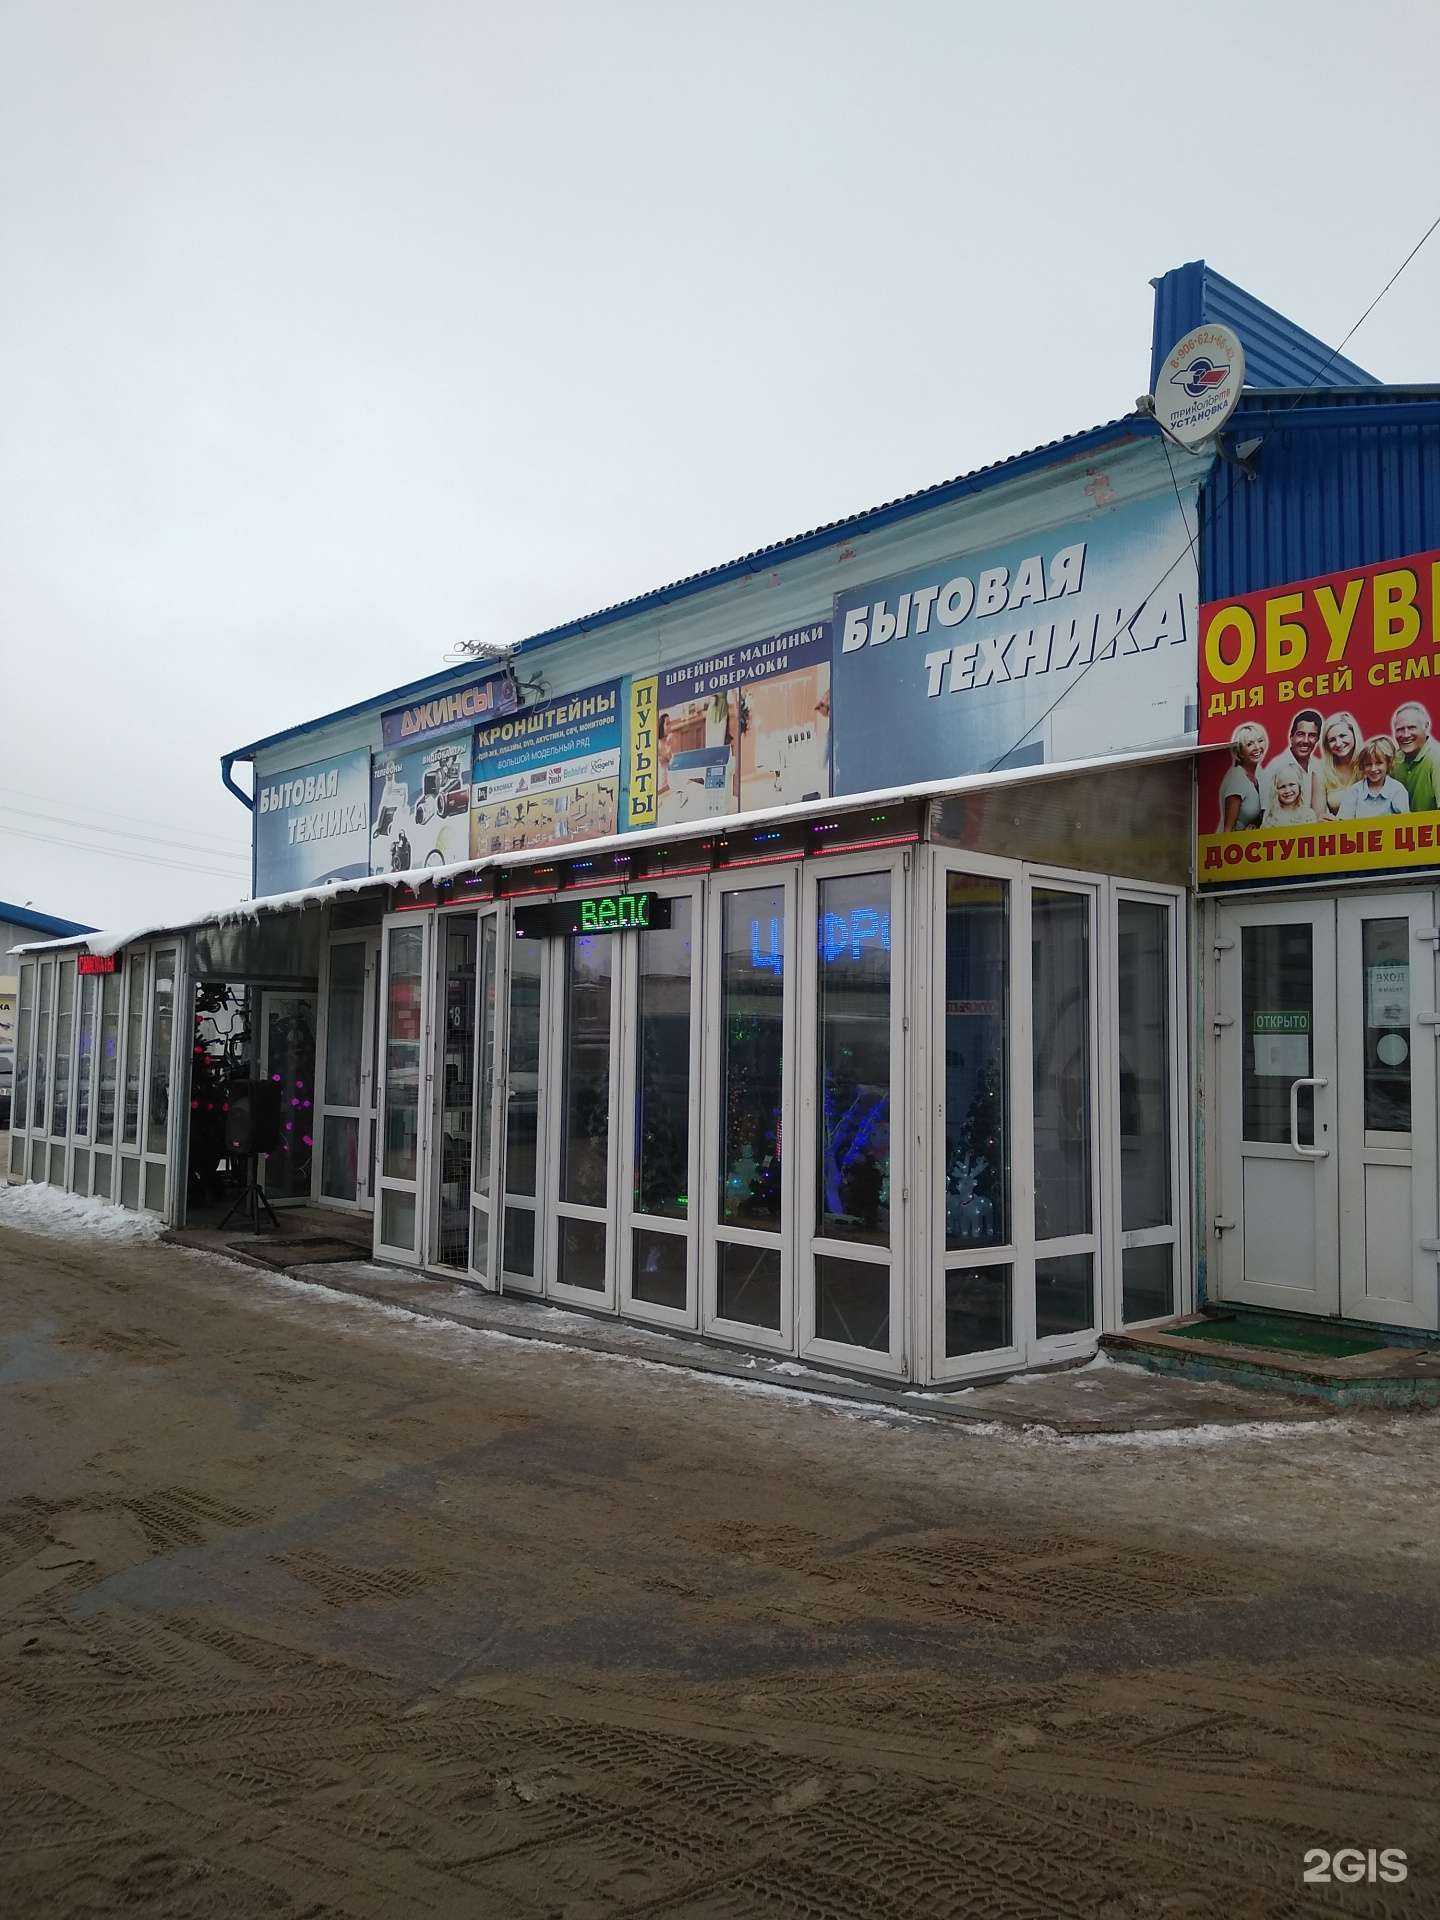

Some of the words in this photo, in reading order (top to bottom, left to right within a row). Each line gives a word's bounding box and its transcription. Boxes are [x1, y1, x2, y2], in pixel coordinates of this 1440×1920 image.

[1170, 400, 1228, 430] УСТАНОВКА
[842, 543, 1088, 654] БЫТОВАЯ
[666, 653, 736, 686] ШВЕЙНЫЕ
[739, 625, 823, 662] МАШИНКИ
[923, 592, 1188, 698] ТЕХНИКА
[694, 680, 704, 694] И
[709, 655, 789, 690] ОВЕРЛОКИ
[1207, 684, 1264, 718] ДЛЯ
[1278, 665, 1353, 703] ВСЕЙ
[401, 682, 494, 737] ДЖИНСЫ
[479, 690, 616, 748] КРОНШТЕЙНЫ
[580, 715, 615, 731] МОНИТОРОВ
[498, 751, 530, 769] БОЛЬШОЙ
[531, 742, 575, 762] МОДЕЛЬНЫЙ
[576, 737, 591, 750] РЯД
[632, 686, 653, 817] ПУЛЬТЫ
[260, 769, 339, 814] БЫТОВАЯ
[288, 801, 367, 846] ТЕХНИКА
[1204, 829, 1383, 870] ДОСТУПНЫЕ
[1256, 1015, 1307, 1028] ОТКРЫТО
